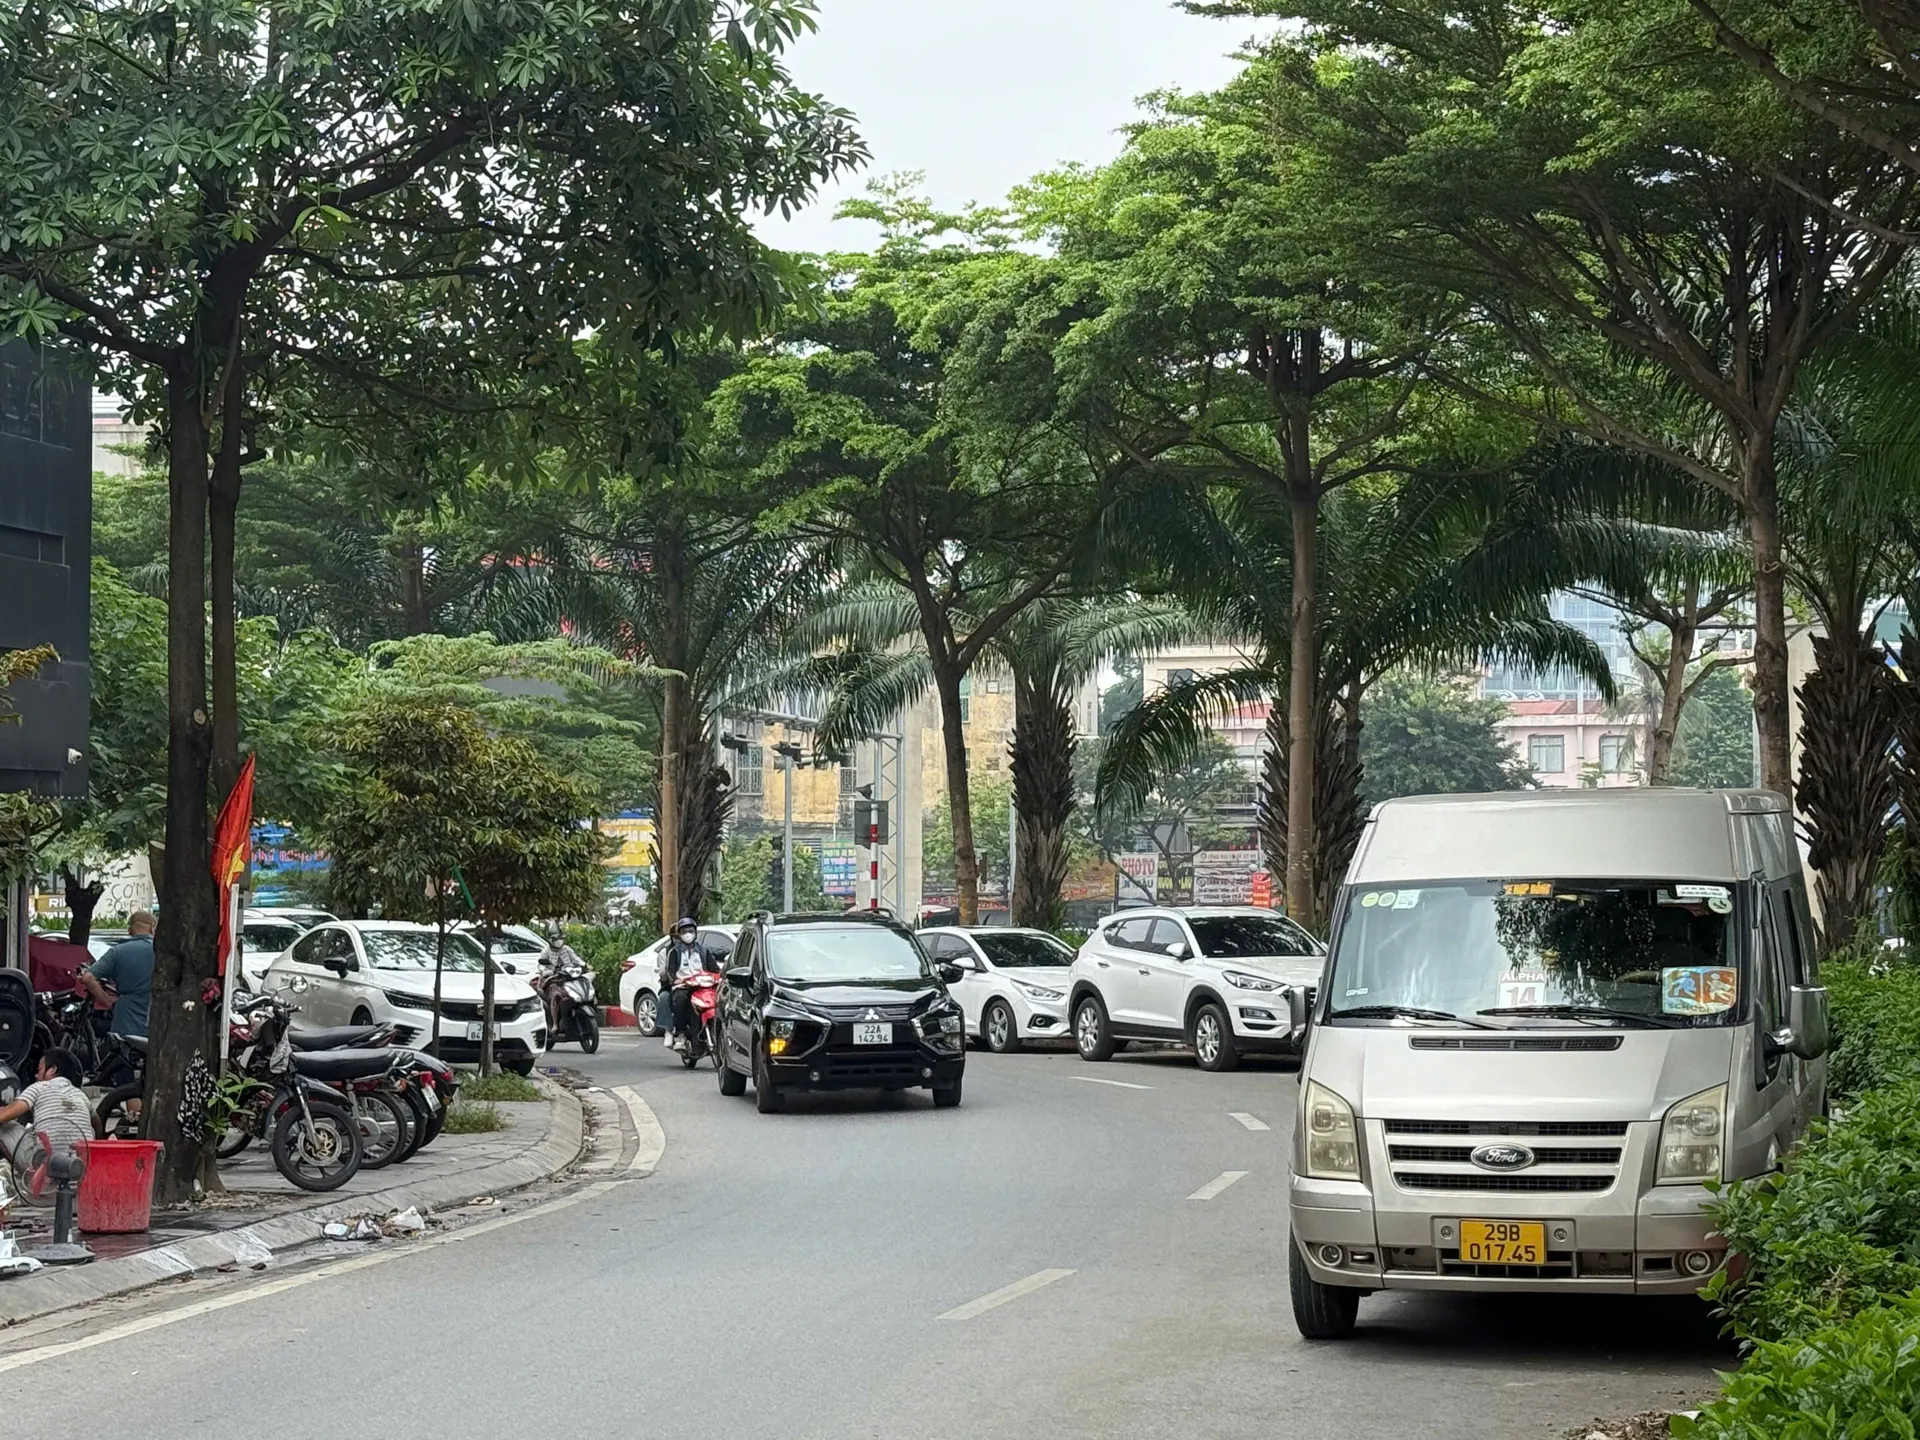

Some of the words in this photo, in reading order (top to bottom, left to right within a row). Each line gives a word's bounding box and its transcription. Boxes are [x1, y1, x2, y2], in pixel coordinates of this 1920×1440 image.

[1121, 857, 1155, 878] PHOTO
[1501, 972, 1545, 982] ALPHA
[1506, 986, 1537, 1006] 14
[864, 1025, 881, 1034] 22A
[1486, 1148, 1518, 1164] Ford
[1484, 1223, 1521, 1242] 29B
[1469, 1242, 1537, 1263] 017.45
